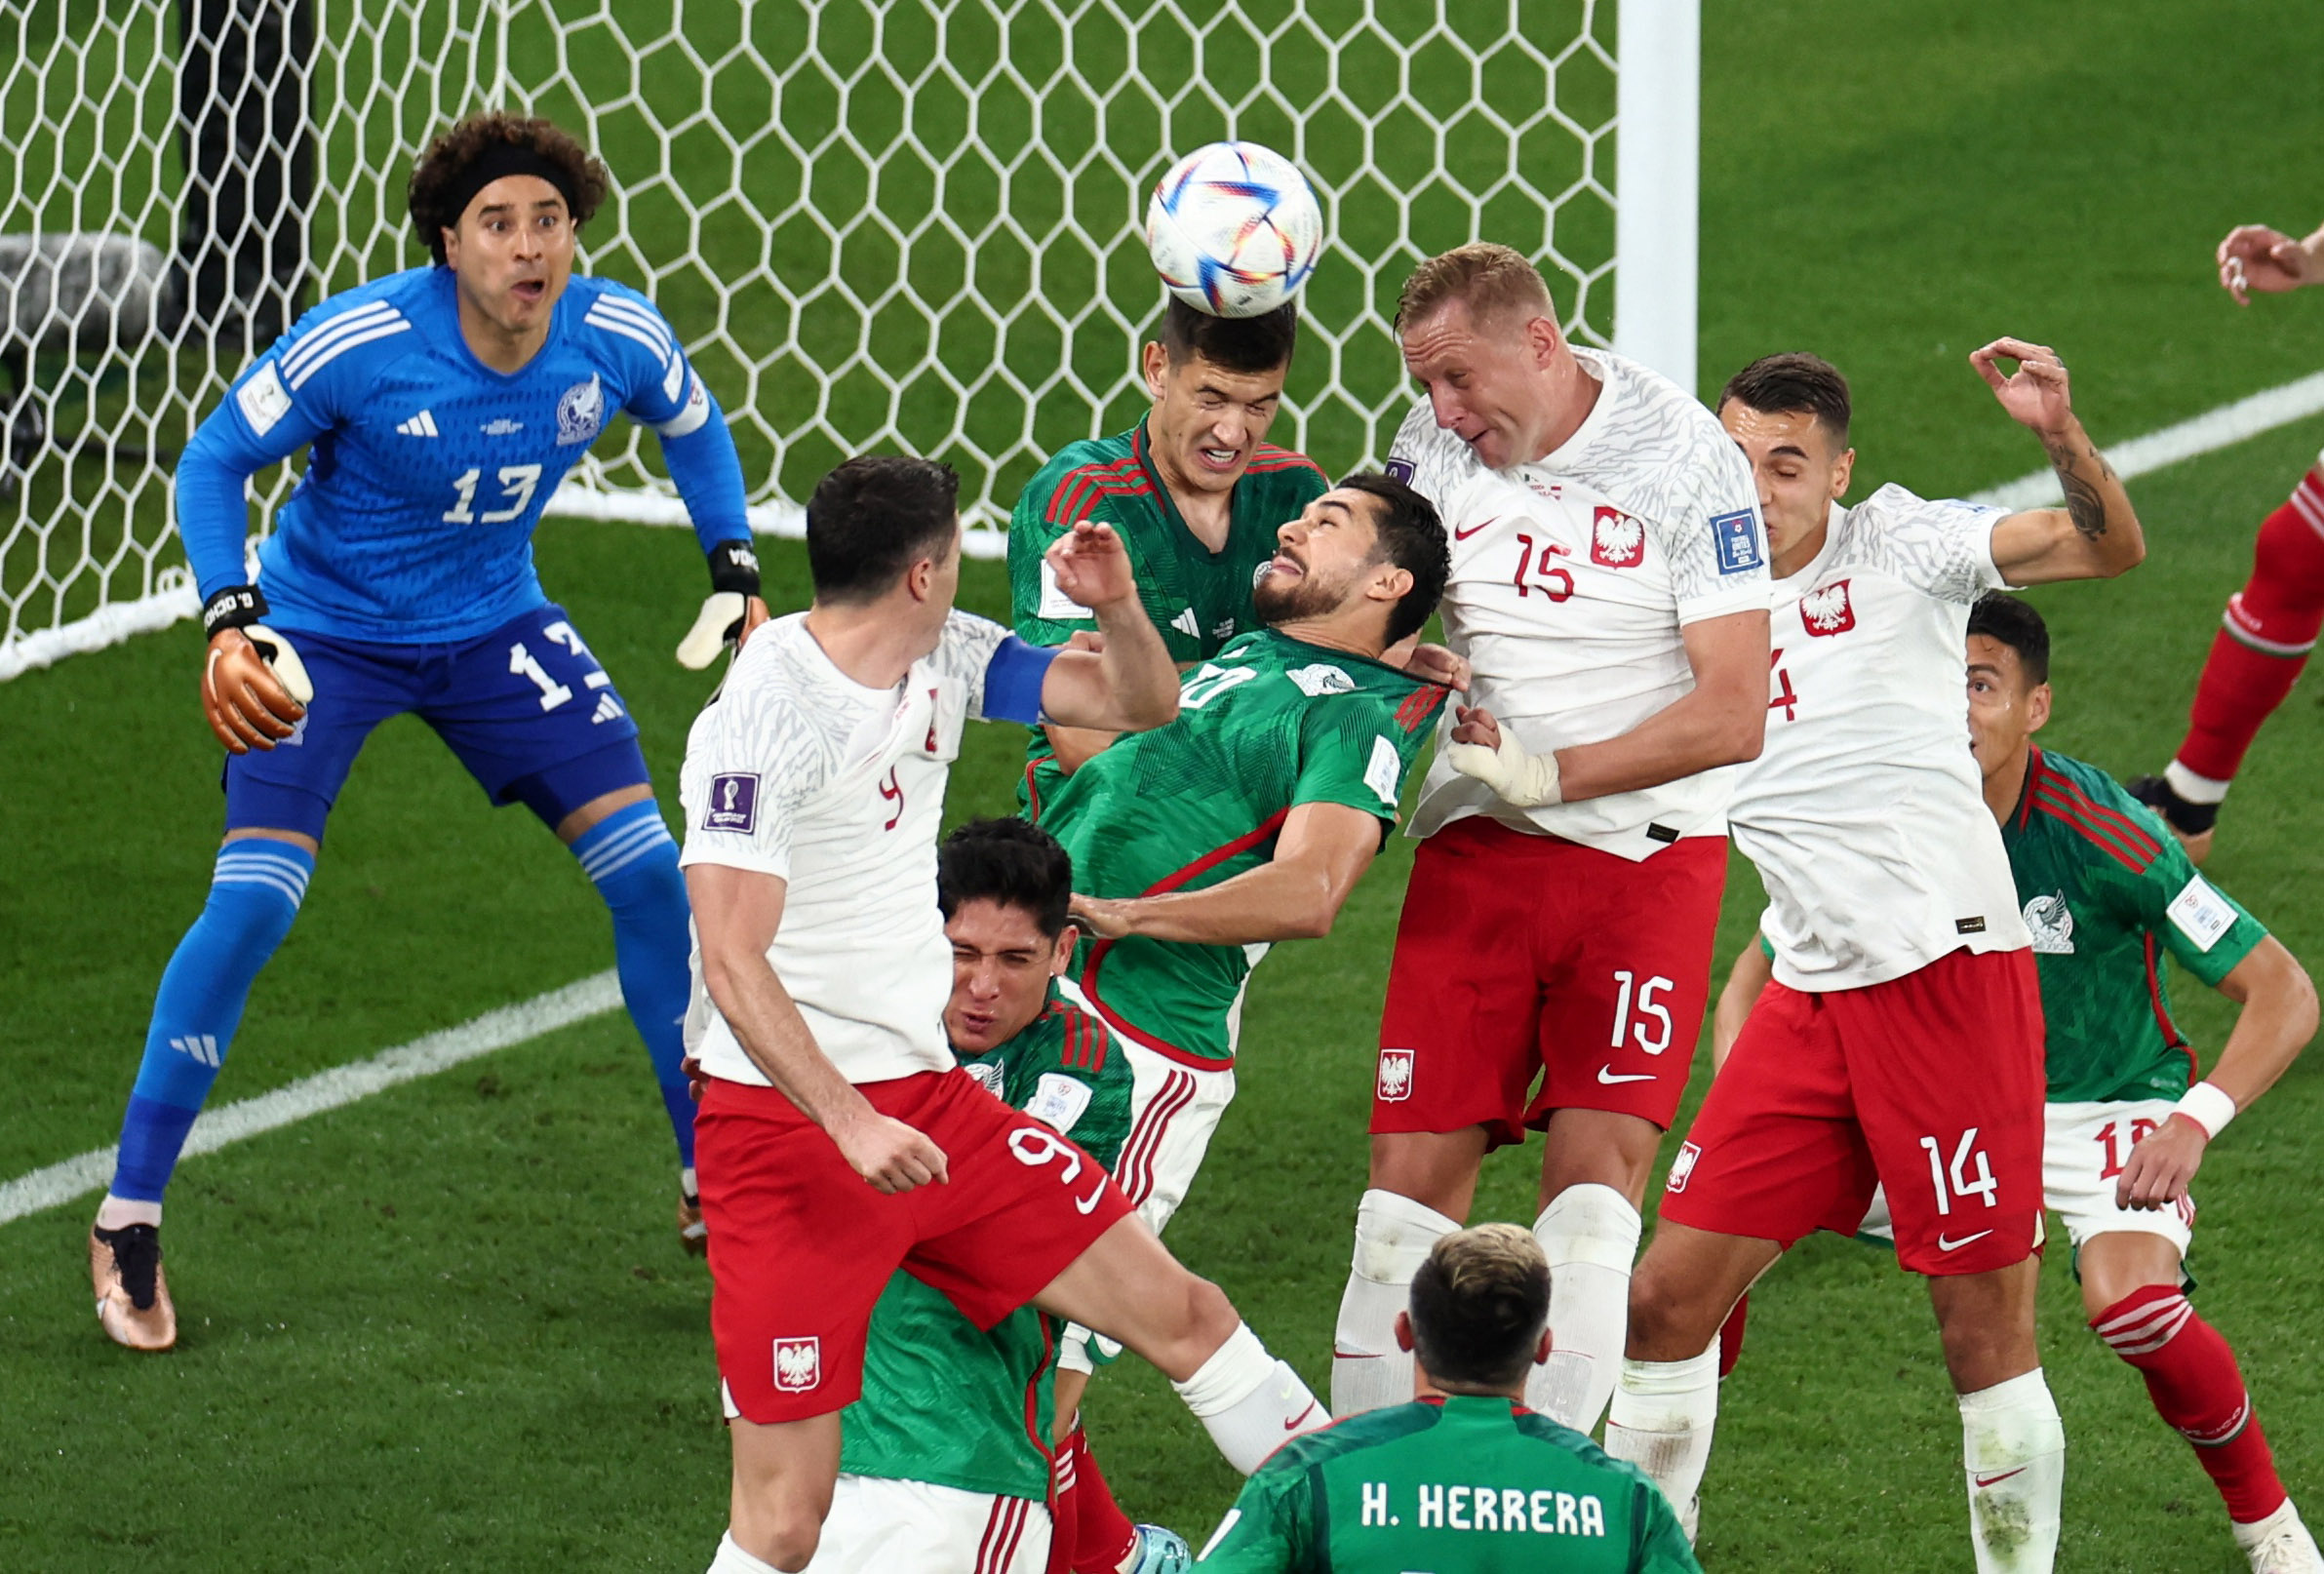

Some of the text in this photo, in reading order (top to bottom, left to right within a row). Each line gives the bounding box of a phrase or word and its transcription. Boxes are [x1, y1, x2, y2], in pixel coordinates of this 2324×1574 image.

[443, 466, 542, 524] 13
[1515, 533, 1575, 603] 15
[204, 595, 237, 632] OCHO
[510, 621, 611, 712] 13
[1611, 970, 1674, 1055] 15
[1008, 1126, 1082, 1183] 9
[1919, 1127, 1997, 1215] 14
[1361, 1482, 1605, 1538] H. HERRERA
